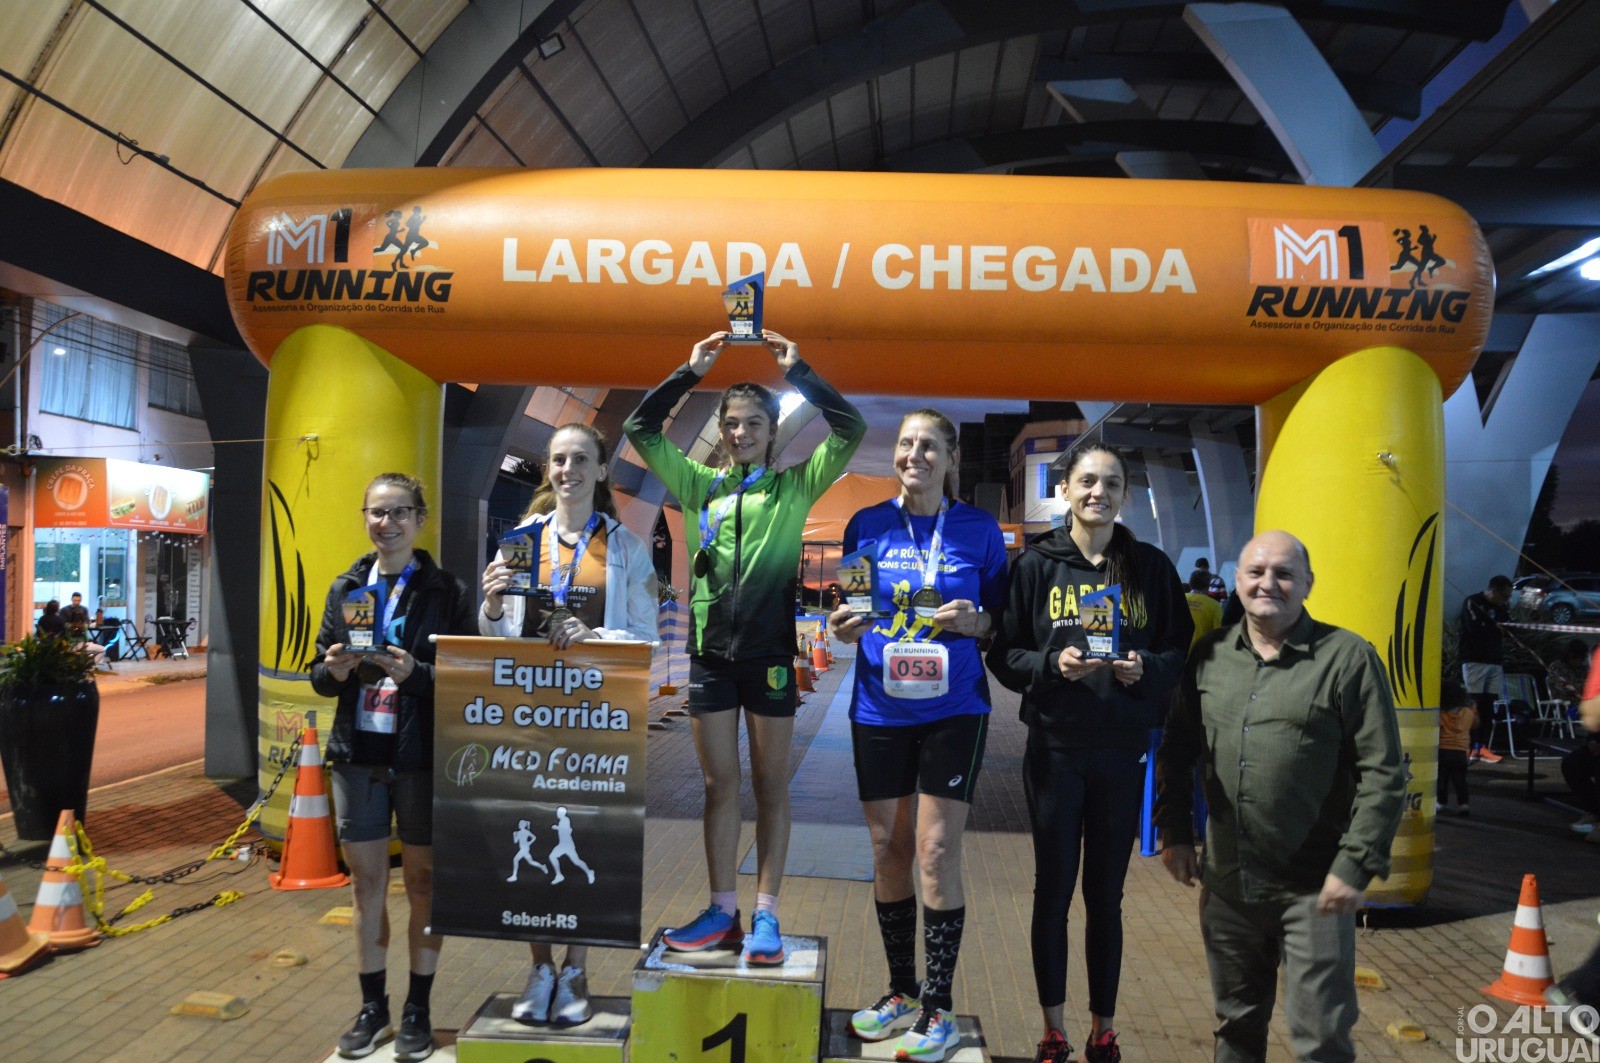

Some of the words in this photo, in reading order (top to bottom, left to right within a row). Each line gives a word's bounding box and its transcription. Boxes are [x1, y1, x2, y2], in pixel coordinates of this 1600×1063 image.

[267, 208, 353, 264] M1
[502, 237, 812, 288] LARGADA
[831, 241, 849, 289] /
[871, 243, 1198, 294] CHEGADA
[1273, 223, 1364, 280] M1
[247, 269, 454, 302] RUNNING
[252, 303, 298, 312] Assessoria
[306, 302, 363, 313] Organização
[363, 303, 376, 311] de
[378, 303, 412, 312] Corrida
[414, 304, 426, 313] de
[427, 305, 445, 313] Rua
[1246, 285, 1471, 324] RUNNING
[1250, 319, 1302, 330] Assessoria
[1312, 320, 1372, 333] Organização
[1374, 321, 1387, 331] de
[1389, 322, 1424, 333] Corrida
[1425, 324, 1437, 333] de
[1438, 324, 1455, 334] Rua
[46, 466, 65, 490] CREPE
[900, 545, 947, 562] RÚTIA
[494, 658, 604, 694] Equipe
[897, 660, 938, 677] 053
[464, 697, 504, 725] de
[513, 702, 629, 731] corrida
[547, 747, 629, 775] FORMA
[532, 774, 626, 793] Academia
[502, 910, 578, 929] Seberi-RS
[702, 1012, 748, 1063] 1
